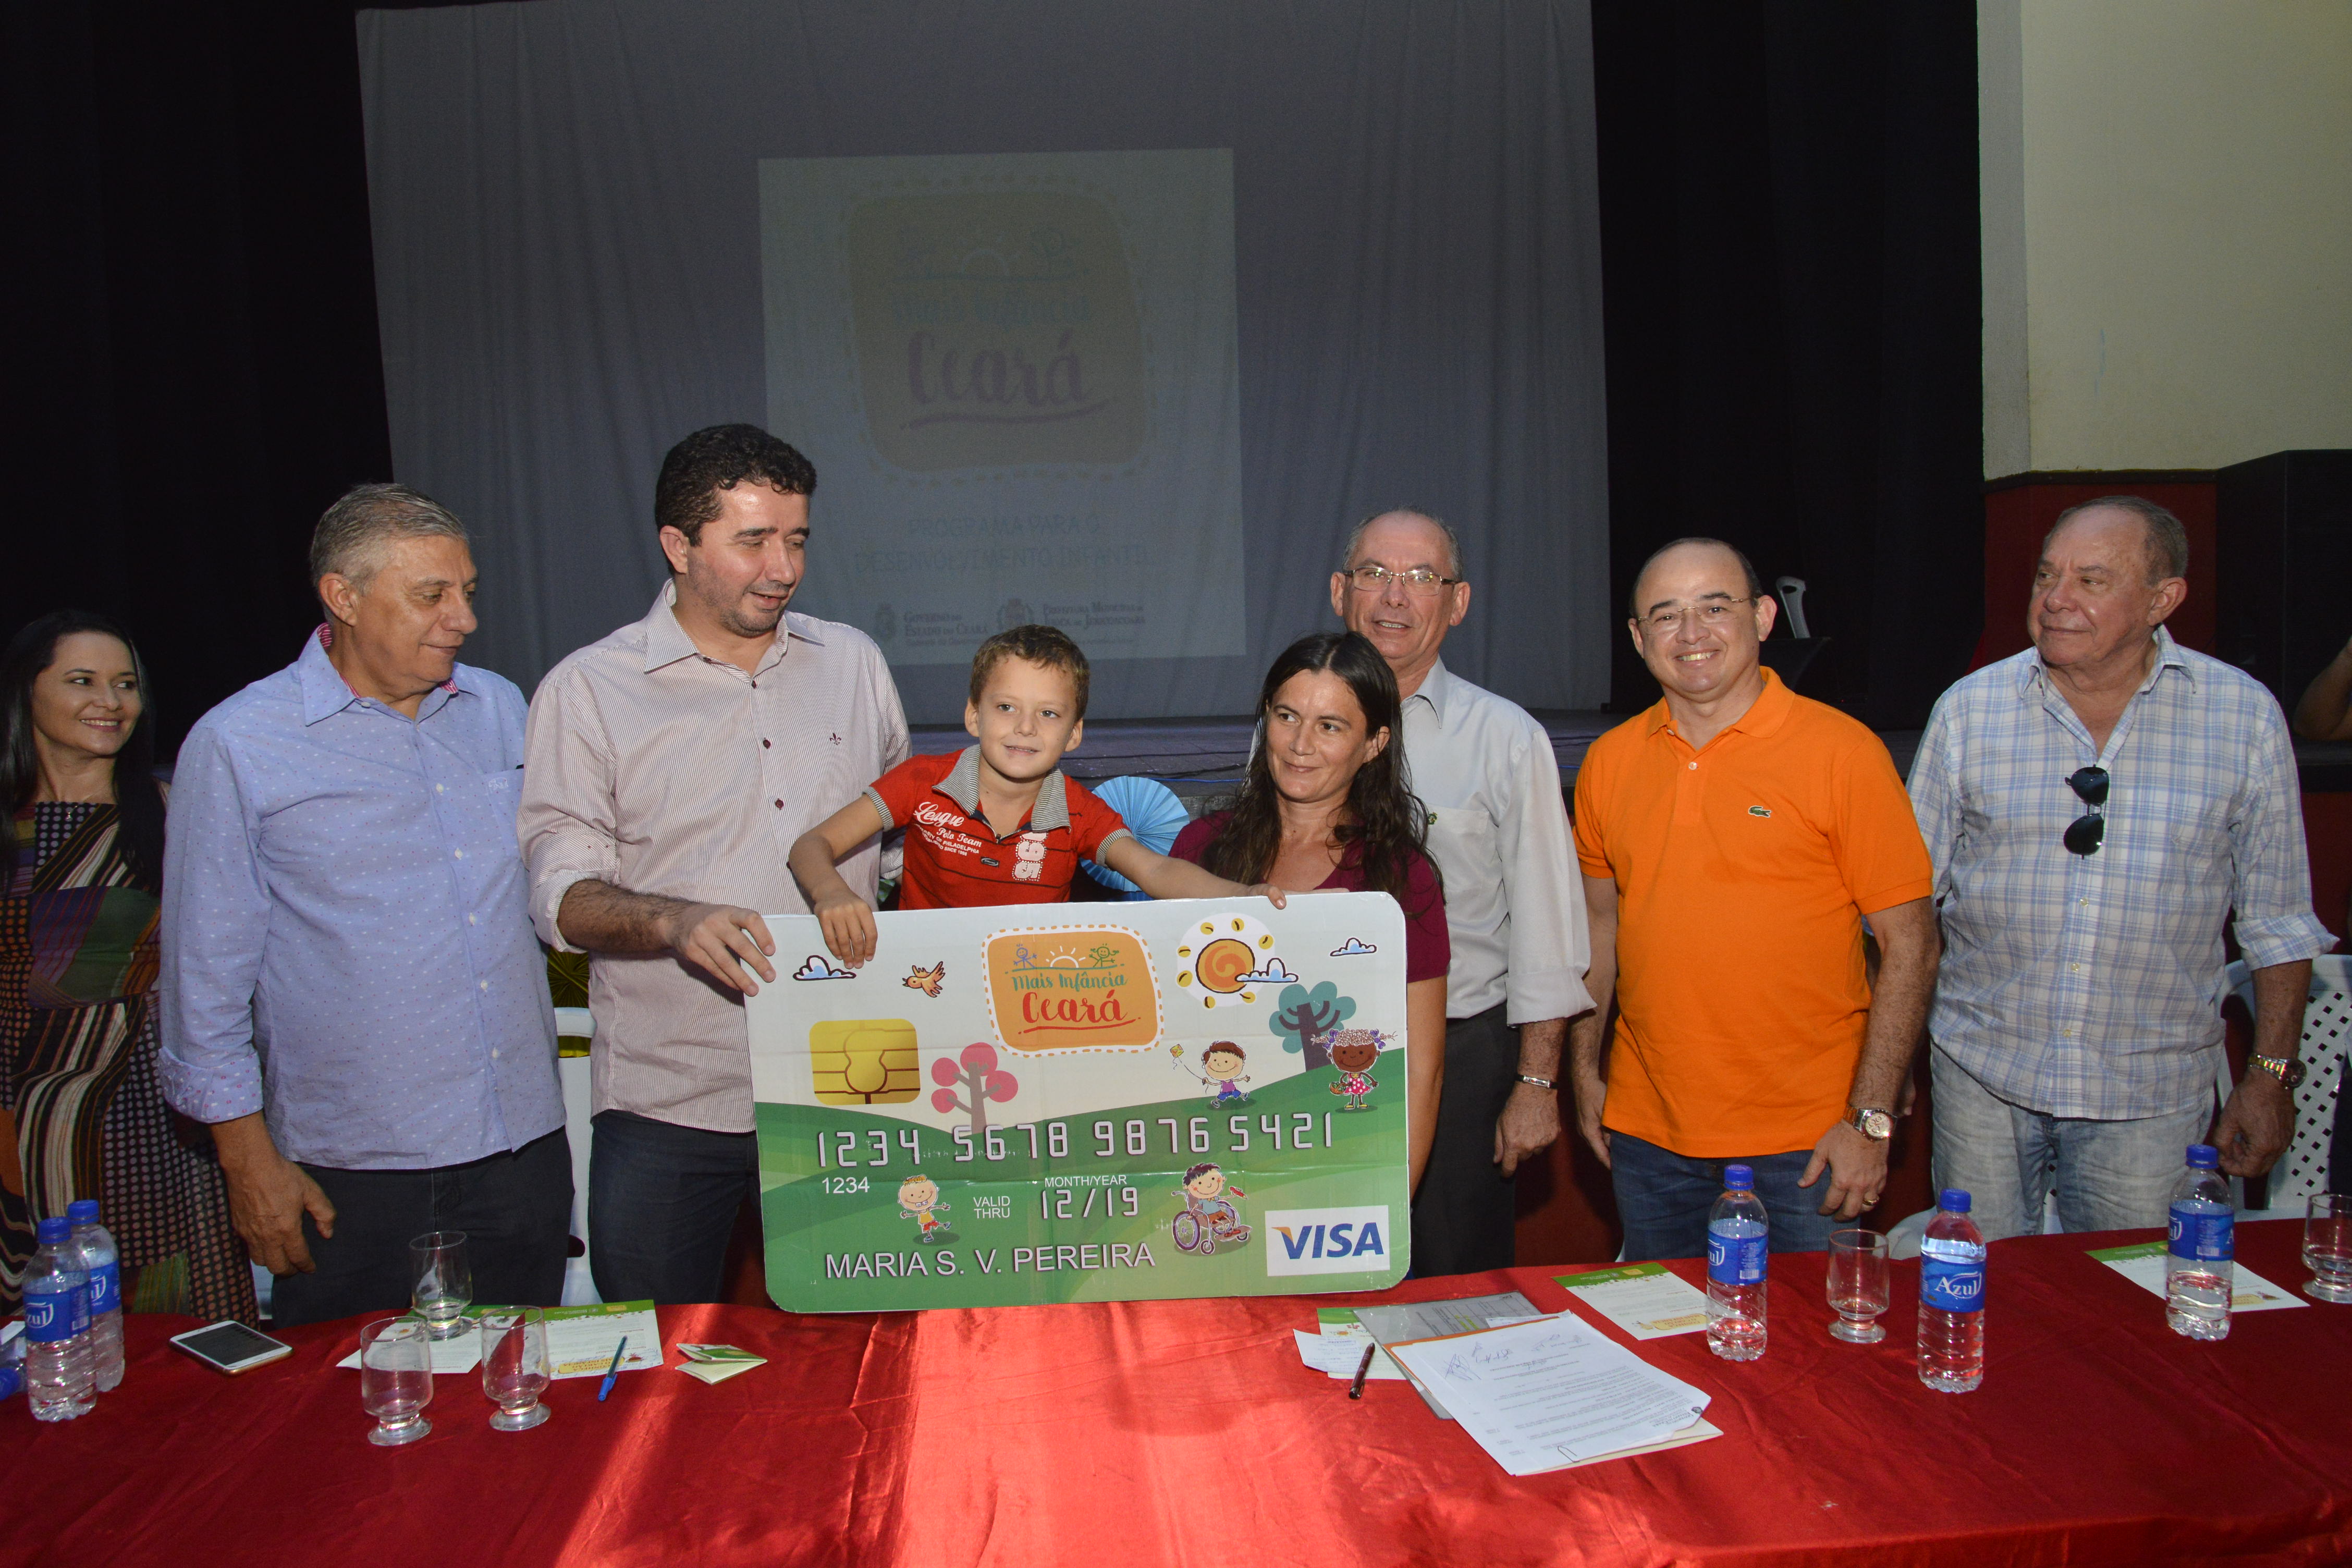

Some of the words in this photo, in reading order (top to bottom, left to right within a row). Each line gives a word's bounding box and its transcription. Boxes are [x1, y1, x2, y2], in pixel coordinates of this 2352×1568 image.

[906, 328, 1093, 406] Ceará
[913, 802, 964, 827] League
[936, 827, 954, 840] Polo
[957, 833, 982, 848] Team
[943, 840, 979, 854] PHILADELPHIA
[1011, 973, 1054, 991] Mais
[1059, 971, 1129, 992] Infância
[1022, 989, 1128, 1023] Ceará
[818, 1129, 920, 1168] 1234
[953, 1122, 1069, 1162] 5678
[1094, 1117, 1210, 1156] 9876
[1229, 1112, 1332, 1152] 5421
[822, 1177, 870, 1194] 1234
[1044, 1174, 1127, 1187] MONTH/YEAR
[973, 1196, 1011, 1207] VALID
[1042, 1186, 1138, 1220] 12/19
[973, 1207, 1011, 1219] THRU
[1271, 1222, 1385, 1260] VISA
[826, 1252, 928, 1279] MARIA
[936, 1251, 964, 1276] S.
[975, 1248, 1001, 1275] V.
[1013, 1243, 1156, 1272] PEREIRA
[1934, 1276, 1978, 1295] Azul
